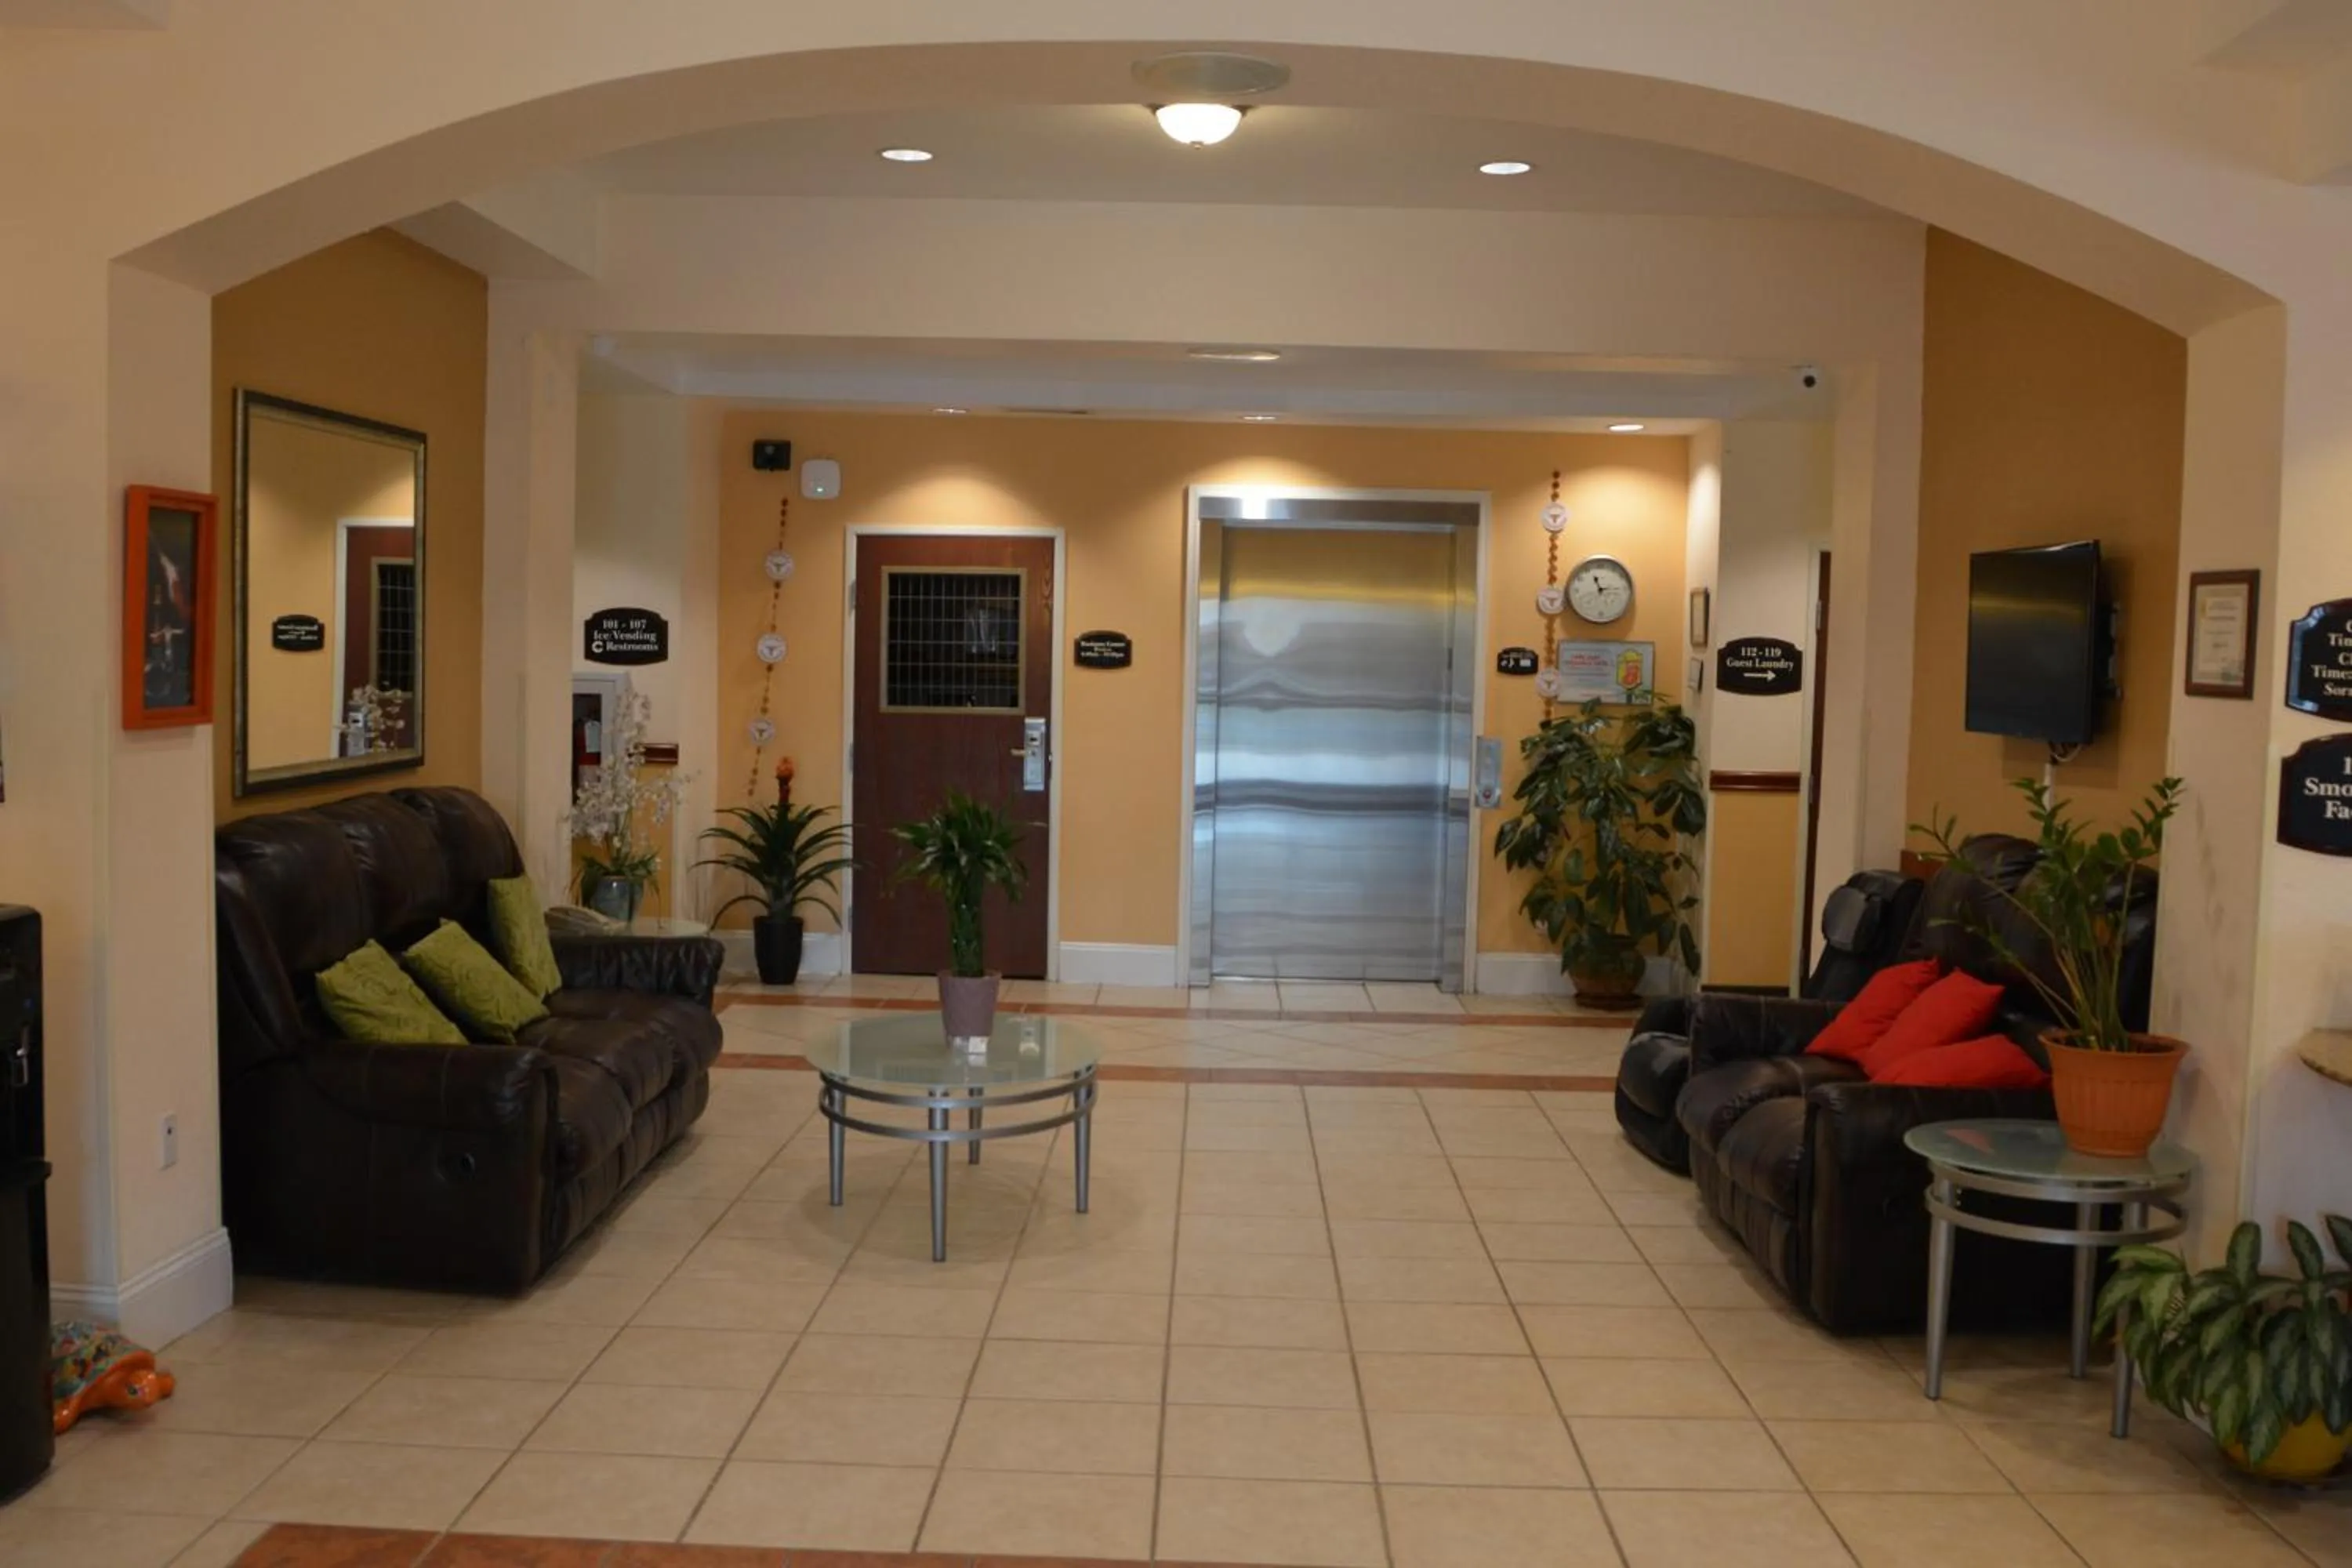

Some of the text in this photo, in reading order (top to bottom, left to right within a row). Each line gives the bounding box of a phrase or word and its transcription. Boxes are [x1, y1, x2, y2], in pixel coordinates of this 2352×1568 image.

[603, 619, 619, 629] 101
[1726, 657, 1794, 672] Guest Laundry
